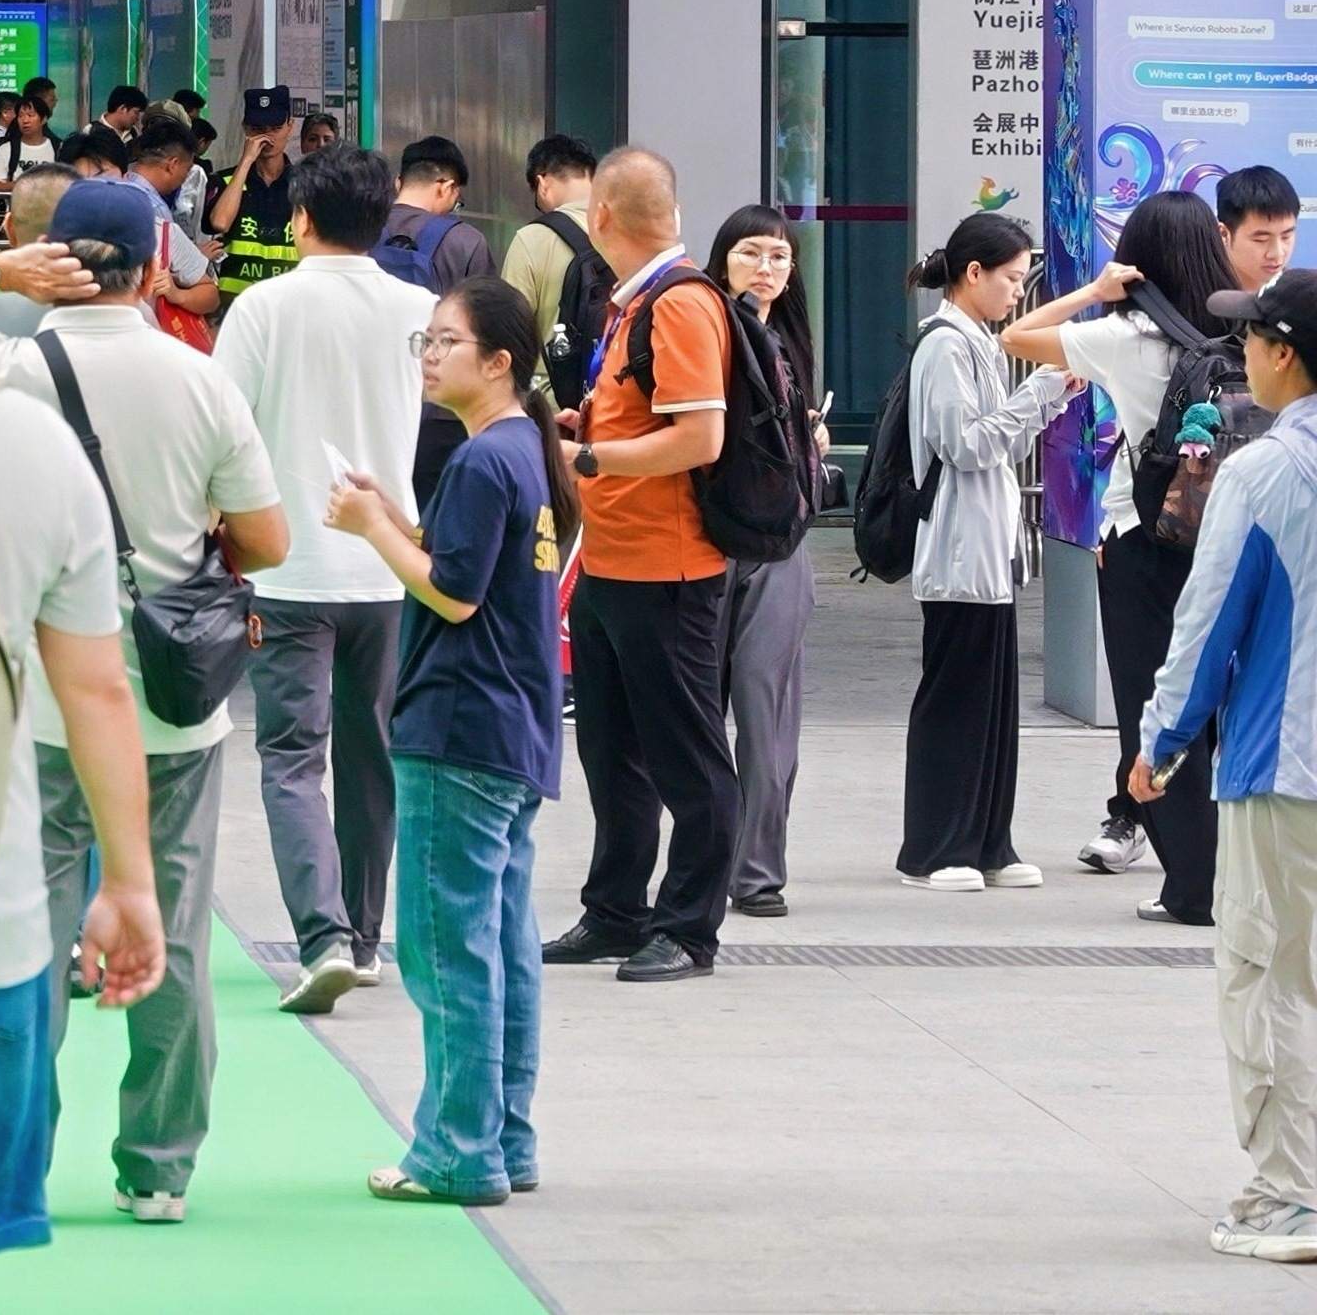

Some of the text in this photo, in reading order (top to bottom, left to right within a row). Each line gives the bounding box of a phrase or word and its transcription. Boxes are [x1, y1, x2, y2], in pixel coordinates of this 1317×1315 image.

[1135, 22, 1266, 35] Where is Service Robots Zone?
[972, 49, 1039, 71] 琶洲港
[972, 74, 1039, 93] Pazho
[1148, 69, 1183, 80] Where
[1186, 71, 1206, 80] can
[1214, 71, 1233, 83] get
[1236, 73, 1255, 84] my
[972, 112, 1039, 135] 会展中
[971, 138, 1042, 156] Exhibi
[241, 217, 258, 239] 安
[239, 262, 263, 278] AN
